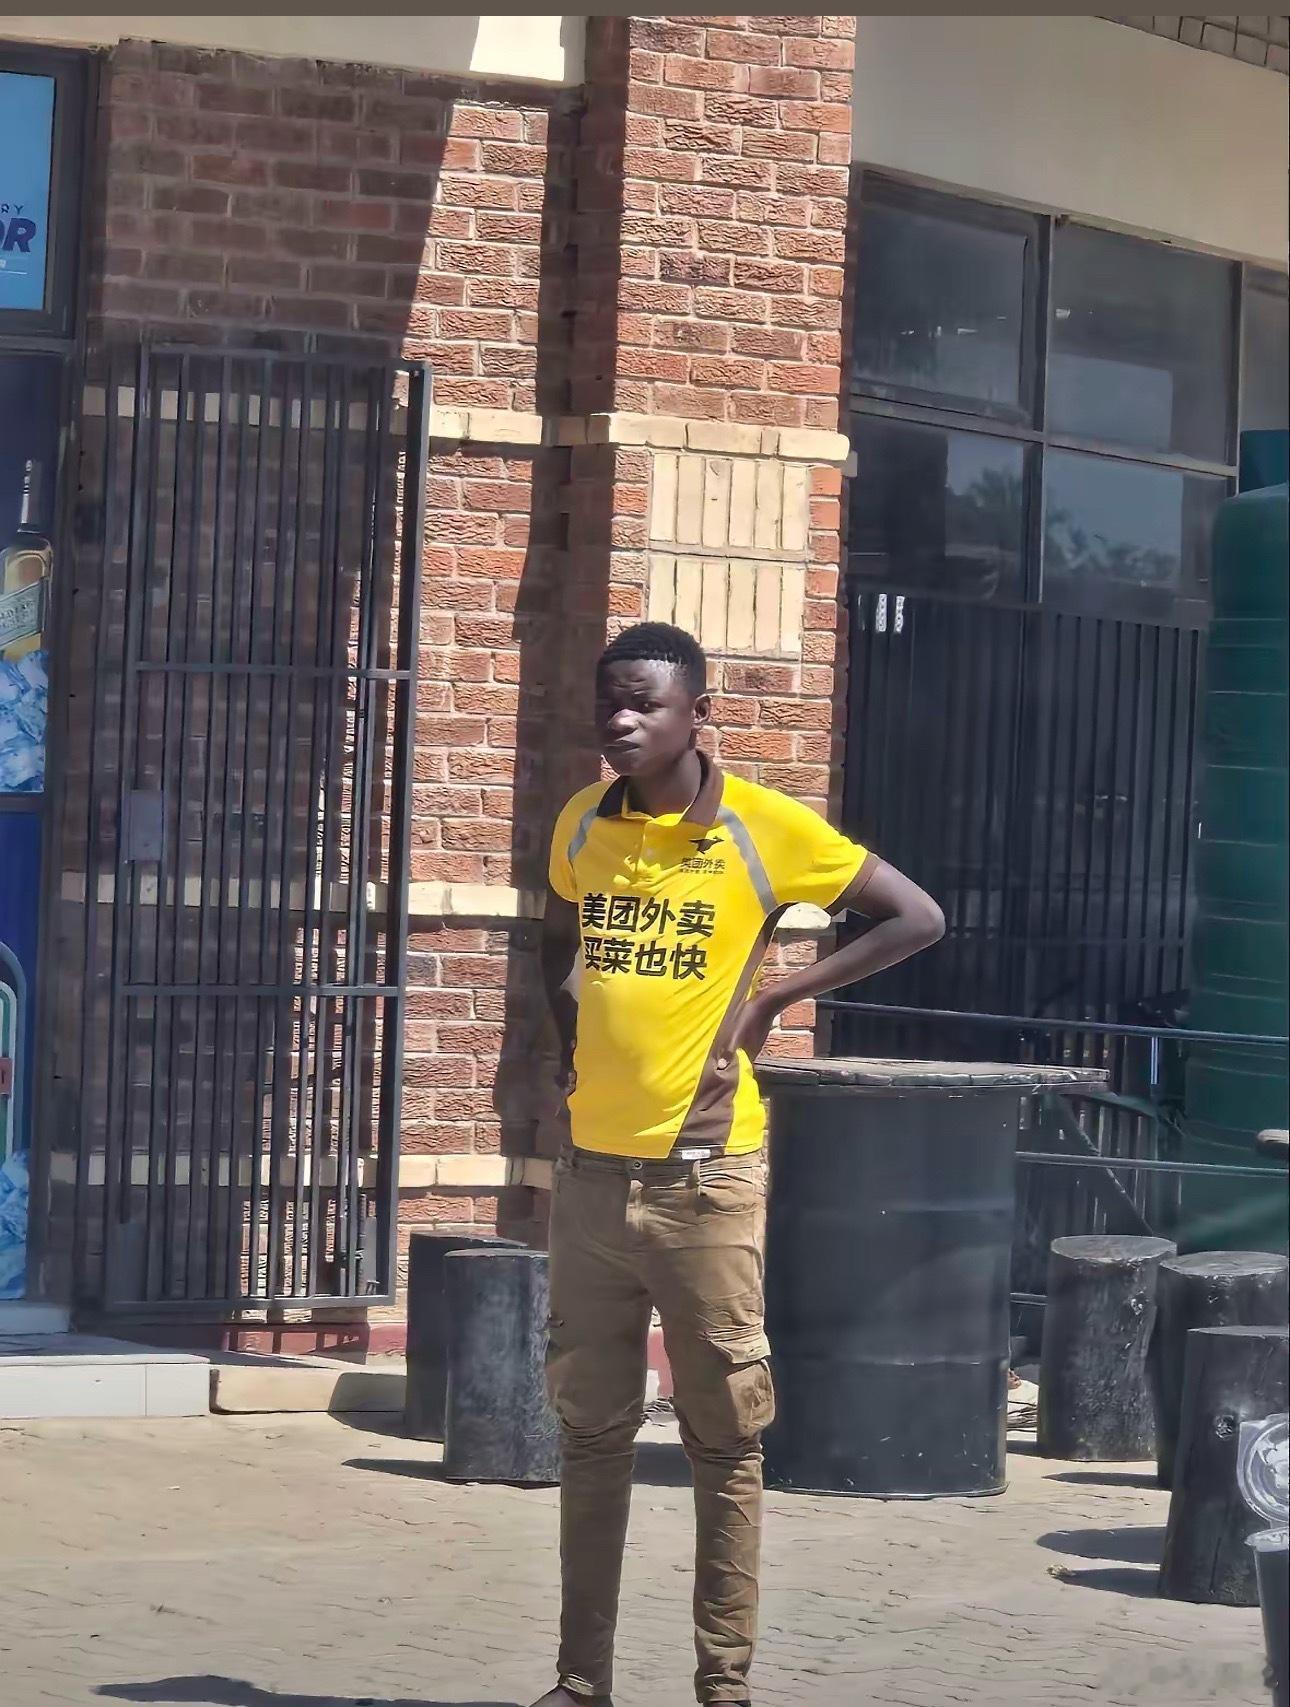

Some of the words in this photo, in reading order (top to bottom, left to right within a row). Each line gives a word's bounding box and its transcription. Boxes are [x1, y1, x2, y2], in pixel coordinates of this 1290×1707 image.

[0, 217, 36, 252] R
[582, 892, 716, 938] 美团外卖
[583, 936, 708, 980] 买菜也快
